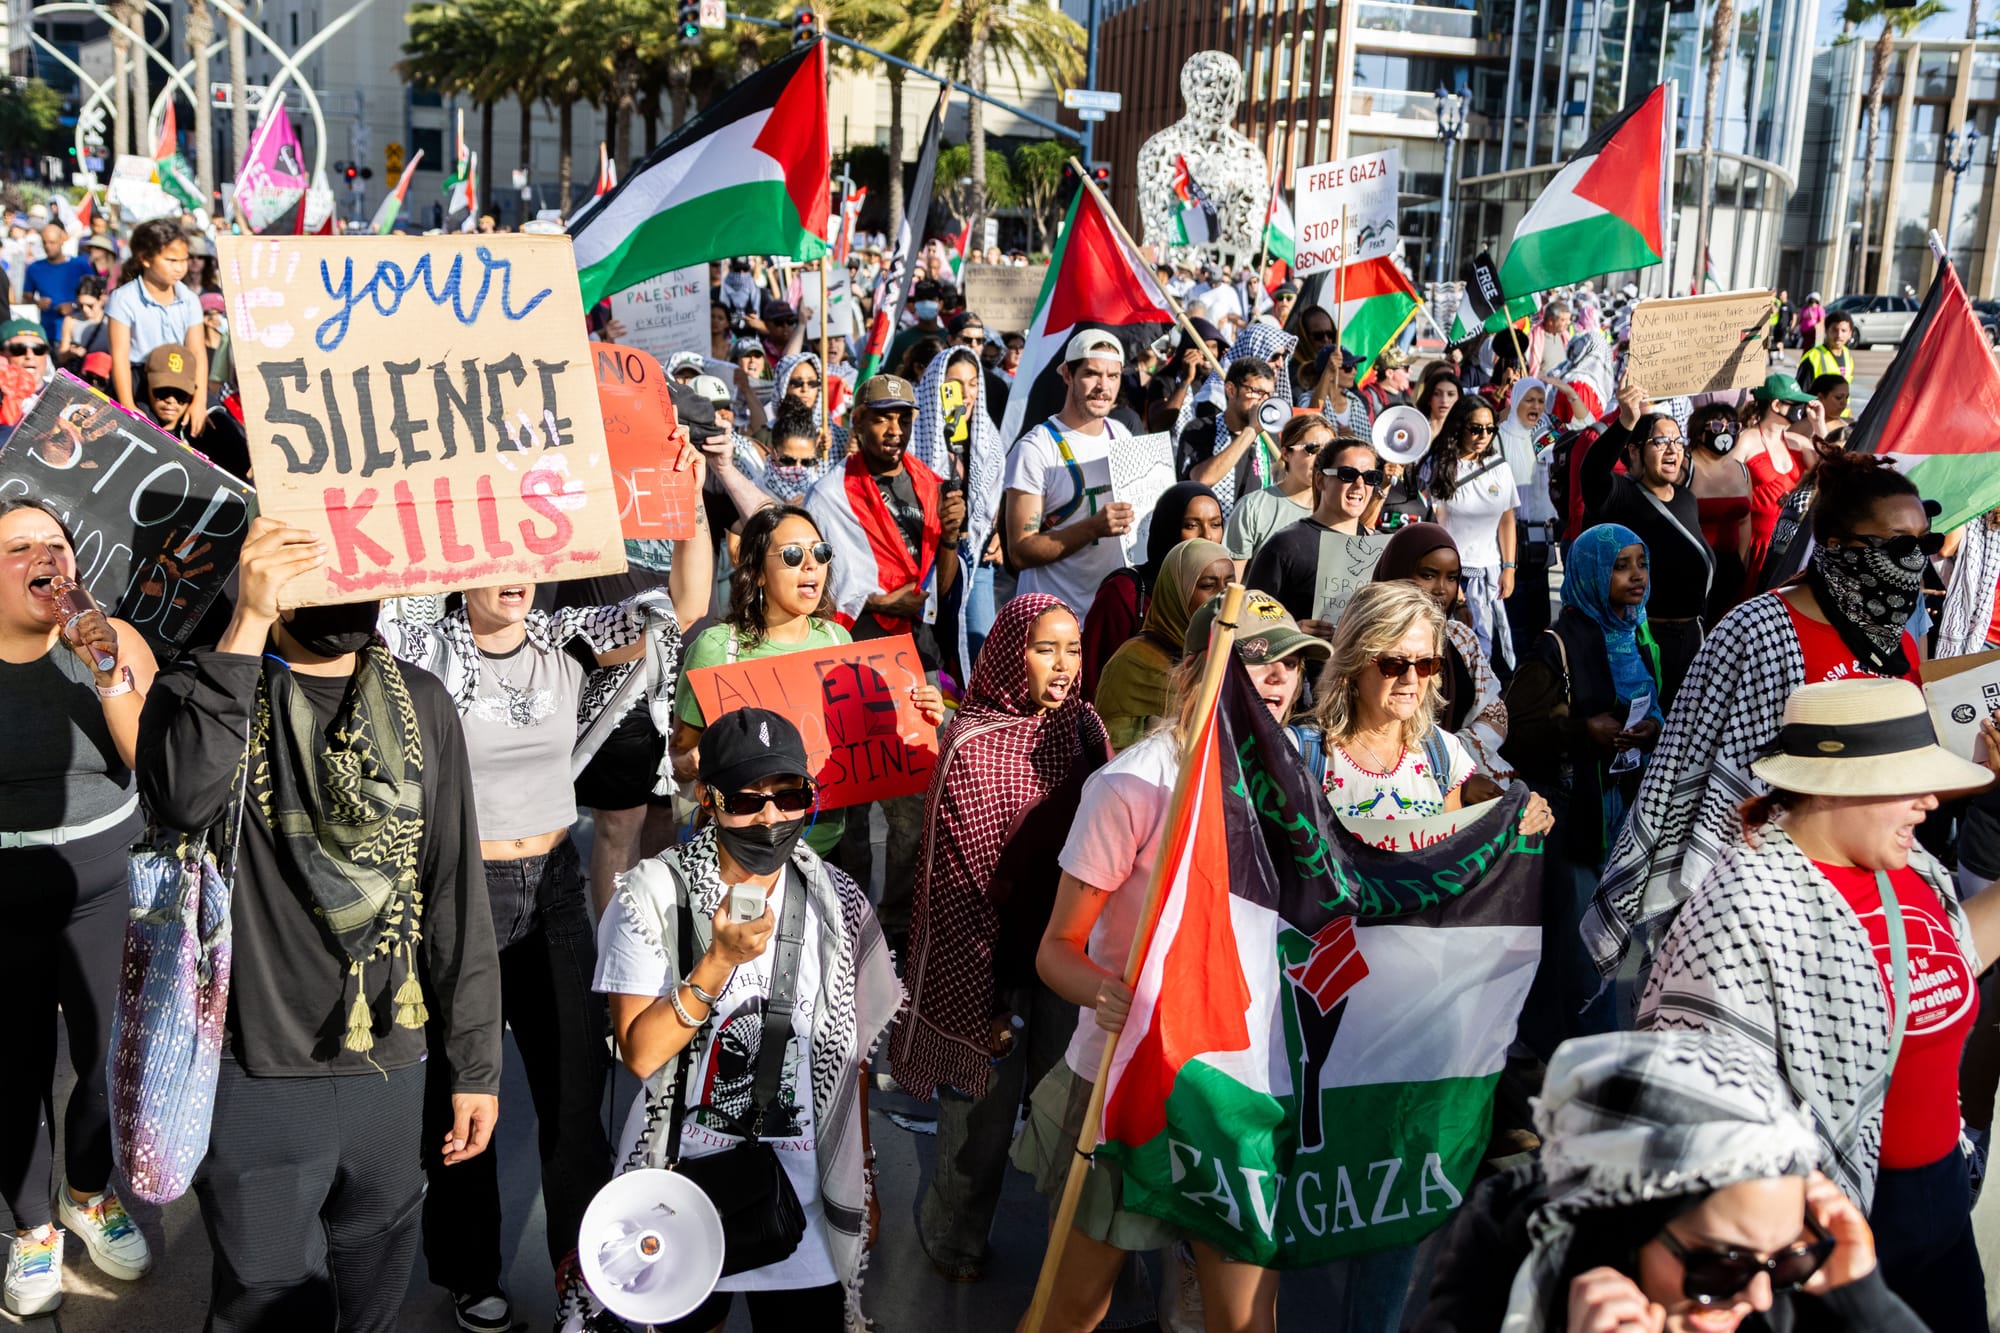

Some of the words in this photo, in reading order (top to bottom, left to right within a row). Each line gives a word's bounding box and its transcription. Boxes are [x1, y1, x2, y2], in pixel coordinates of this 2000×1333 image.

[1309, 168, 1344, 193] FREE
[1349, 158, 1387, 183] GAZA
[1303, 218, 1339, 243] STOP
[314, 244, 553, 352] your
[626, 281, 701, 305] PALESTINE
[1476, 265, 1499, 300] FREE
[597, 351, 645, 384] NO
[257, 351, 575, 478] SILENCE
[26, 402, 248, 560] STOP
[322, 469, 576, 576] KILLS
[713, 666, 808, 714] ALL
[813, 651, 918, 705] EYES
[1915, 955, 1929, 970] for
[1296, 1153, 1463, 1237] GAZA
